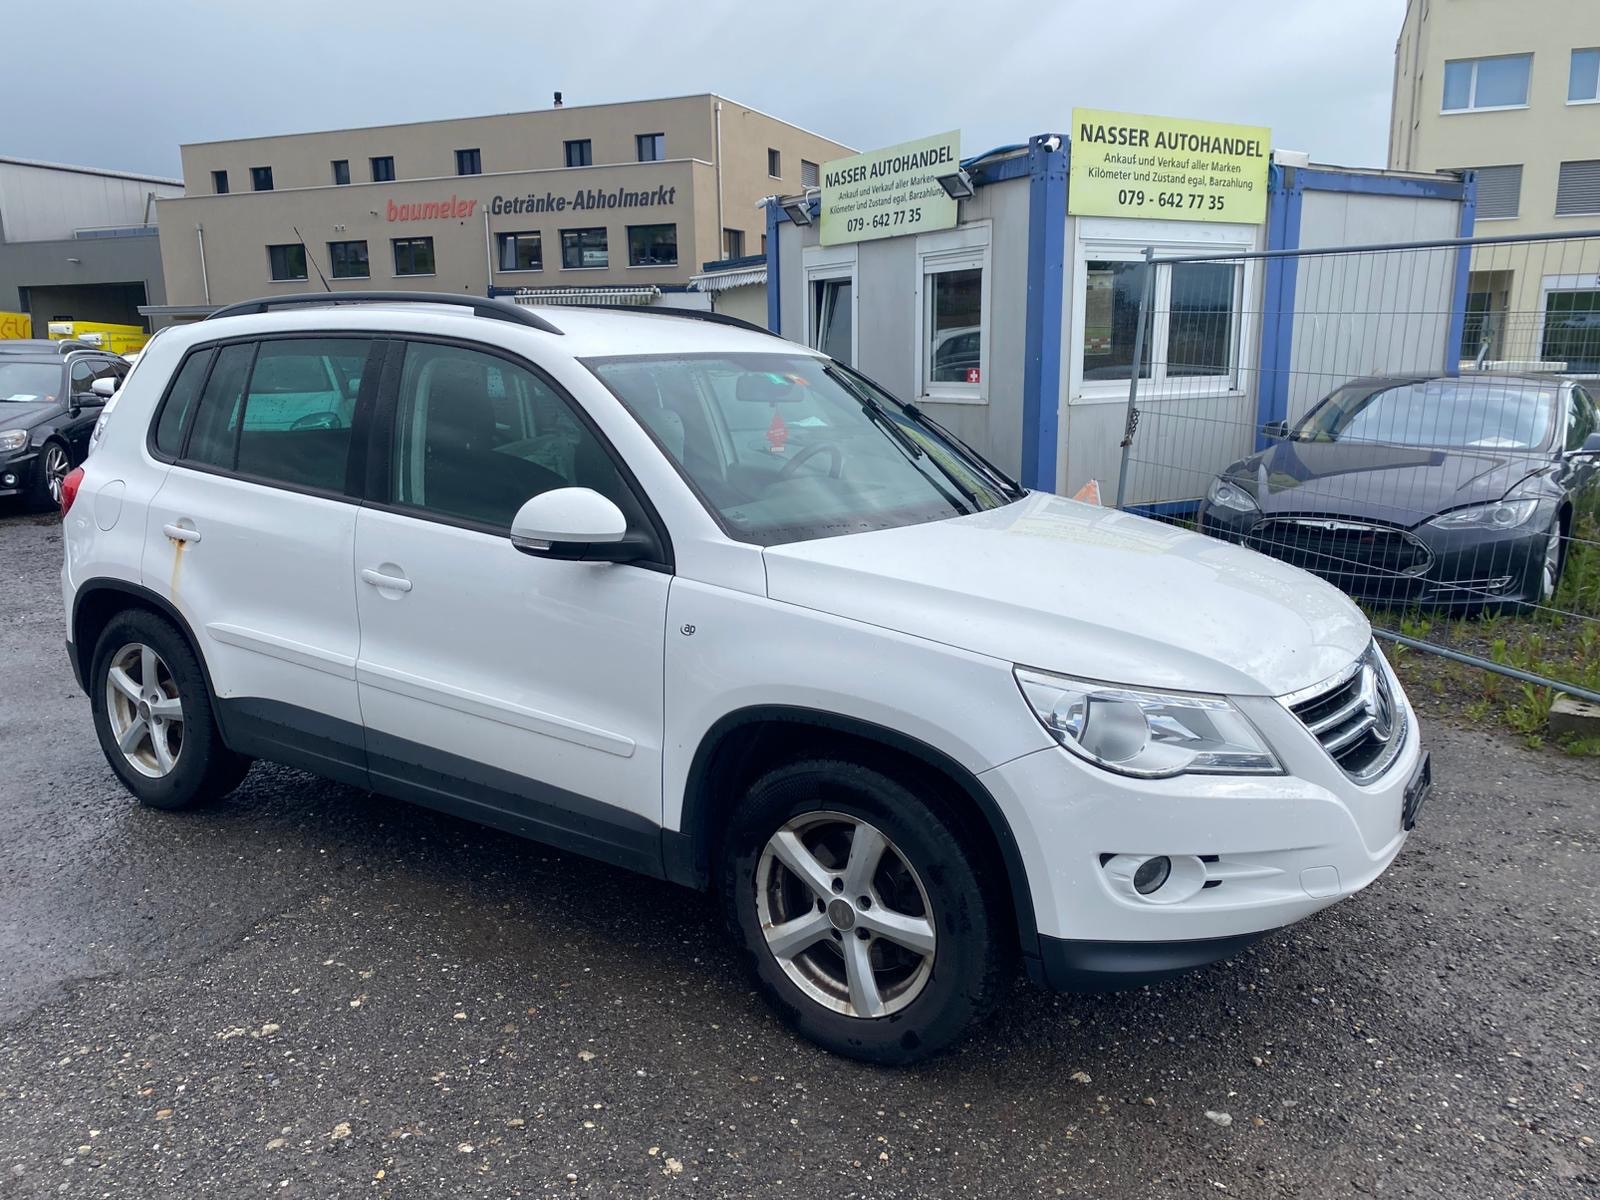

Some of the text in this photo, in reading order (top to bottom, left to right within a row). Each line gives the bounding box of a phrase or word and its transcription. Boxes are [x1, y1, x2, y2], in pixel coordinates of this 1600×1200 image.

[1080, 124, 1263, 157] NASSER AUTOHANDEL
[826, 146, 953, 188] NASSER AUTOHANDEL
[1104, 152, 1240, 172] Ankauf und Verkauf aller Marken
[838, 174, 934, 200] Ankauf und Verkauf aller Marken
[1088, 167, 1253, 191] Kilometer und Zustand egal, Barzahlung
[386, 195, 477, 222] baumeler
[492, 186, 676, 216] Getränke-Abholmarkt
[830, 187, 945, 215] Kilometer und Zustand egal, Barzahlung
[1118, 190, 1144, 206] 079
[1158, 192, 1183, 208] 642
[1188, 194, 1204, 208] 77
[1208, 196, 1224, 210] 35
[848, 218, 864, 232] 079
[872, 214, 890, 228] 642
[894, 210, 906, 224] 77
[908, 208, 922, 222] 35
